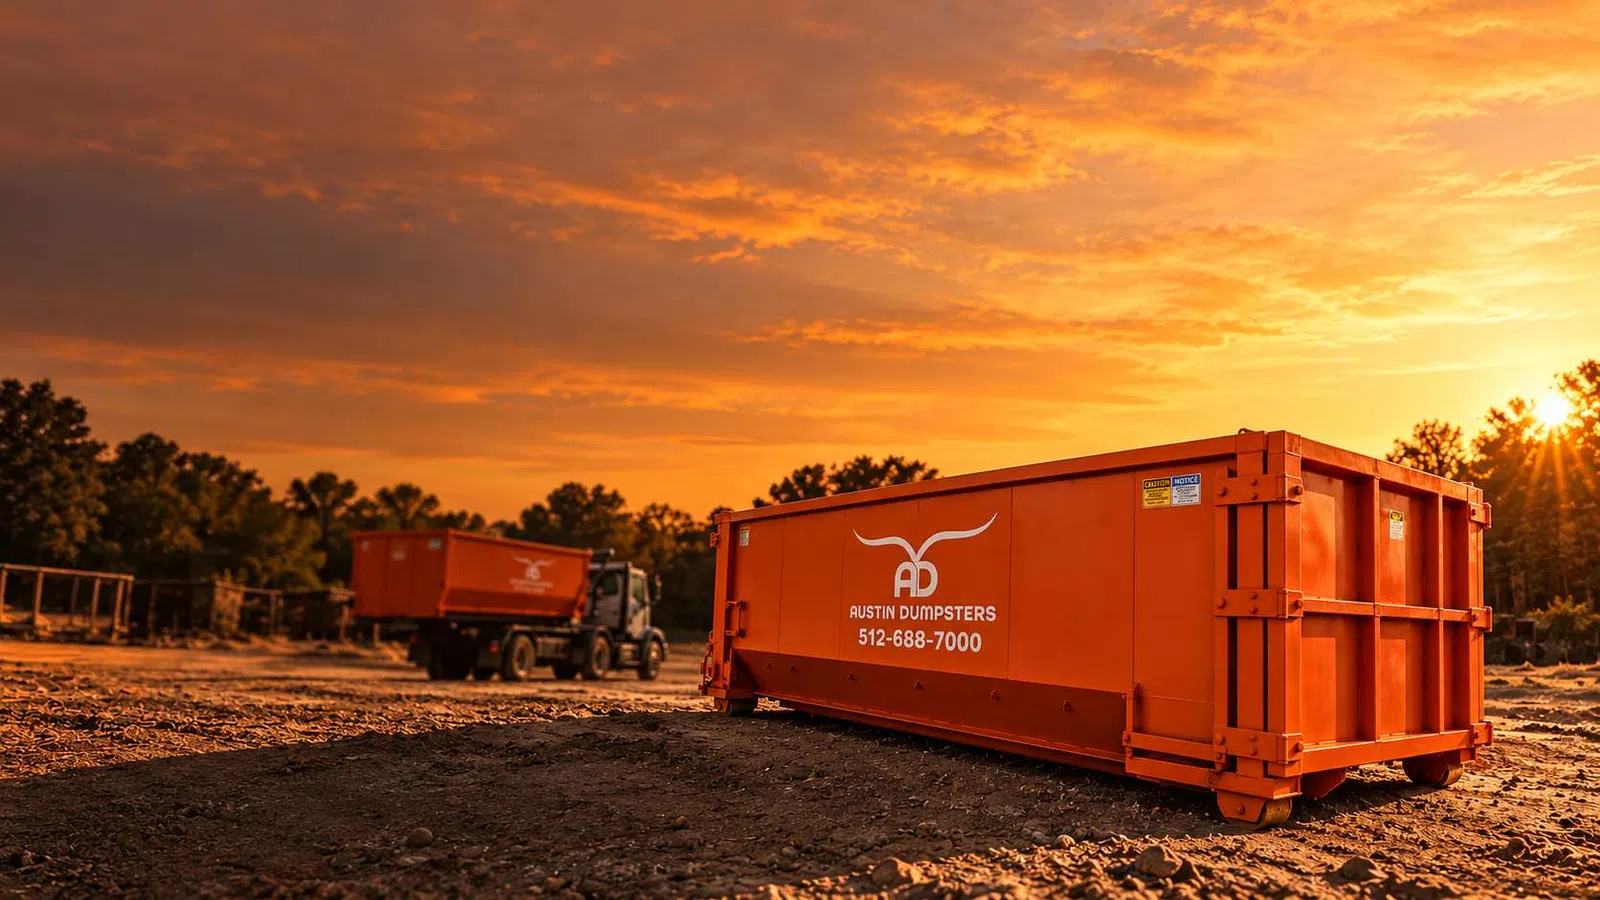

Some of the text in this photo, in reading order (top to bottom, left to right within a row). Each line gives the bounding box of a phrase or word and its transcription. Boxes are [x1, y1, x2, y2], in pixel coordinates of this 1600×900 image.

[1174, 476, 1199, 485] NOTICE
[894, 561, 939, 598] AD
[849, 605, 997, 622] AUSTIN DUMPSTERS
[858, 628, 982, 653] 512-688-7000
